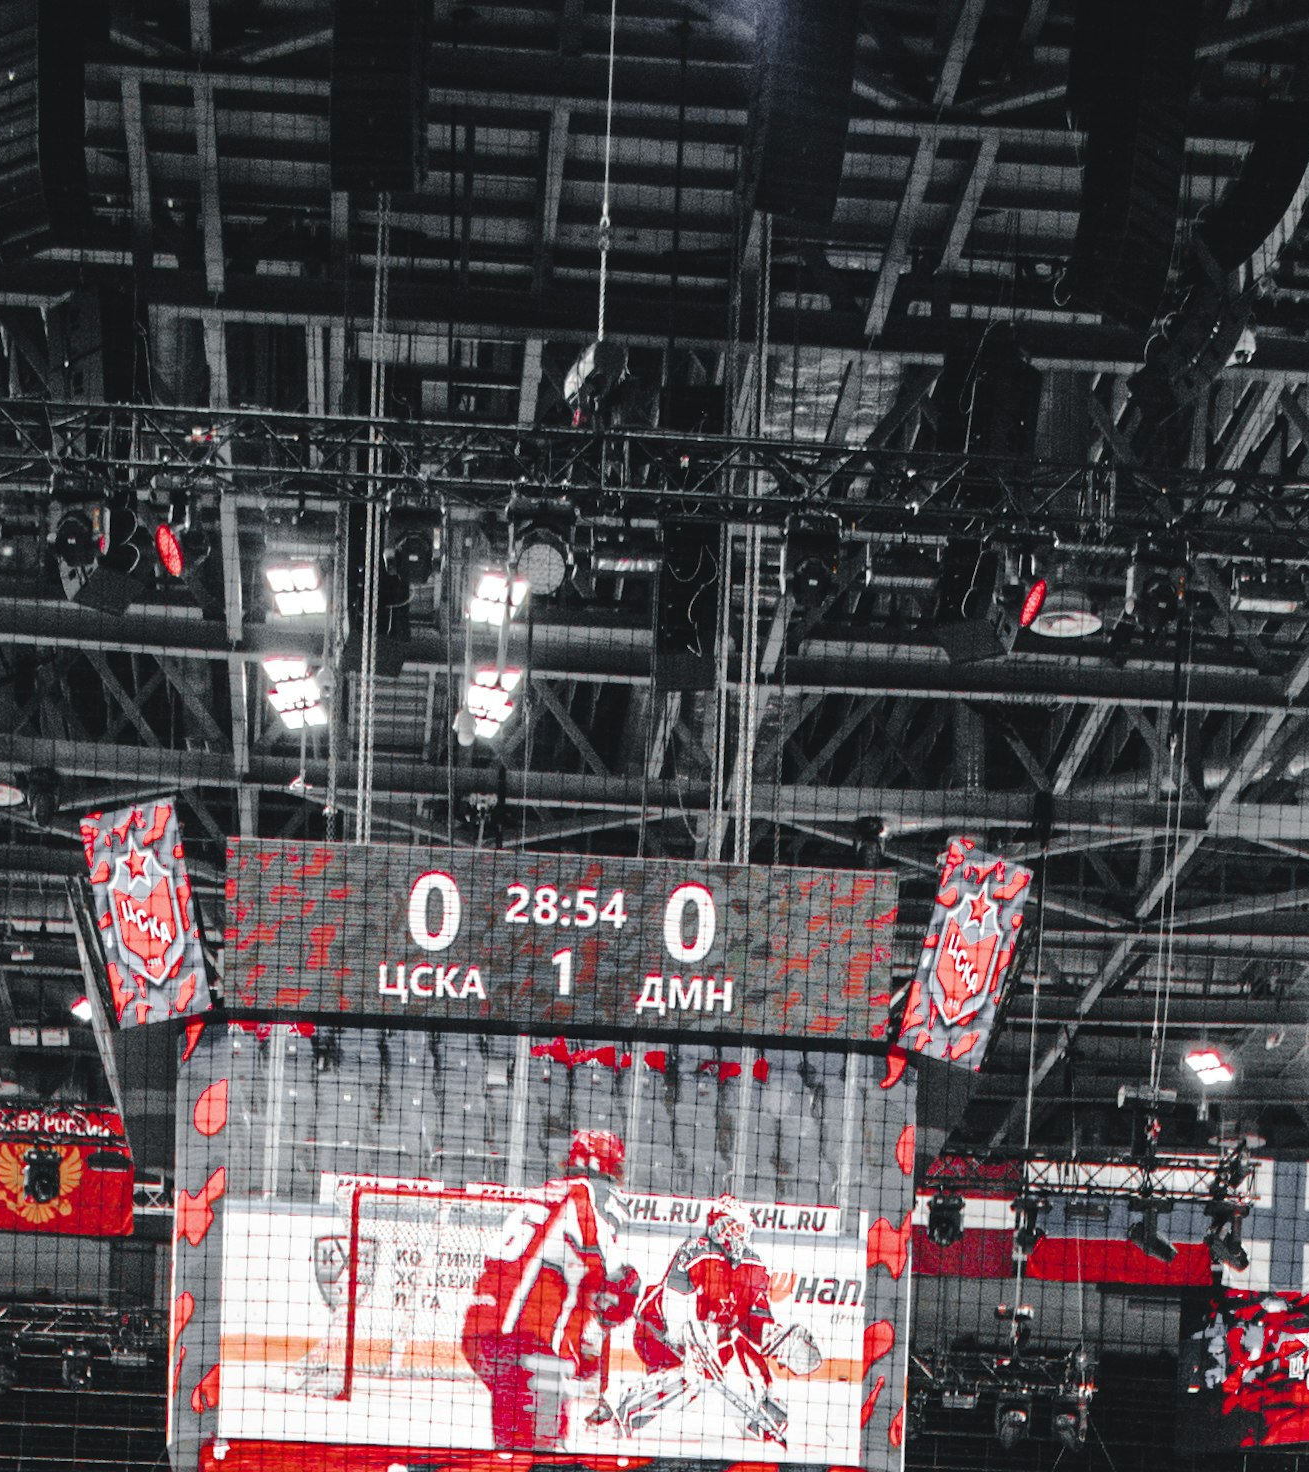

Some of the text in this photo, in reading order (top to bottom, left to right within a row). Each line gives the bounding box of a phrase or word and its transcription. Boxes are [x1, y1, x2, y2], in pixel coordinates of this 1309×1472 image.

[121, 899, 173, 945] ЦСКА
[408, 870, 461, 951] 0
[505, 882, 627, 929] 28:54
[663, 881, 717, 963] 0
[378, 960, 487, 1004] ЦСКА
[552, 947, 572, 996] 1
[946, 933, 979, 995] ЦСКА
[635, 972, 734, 1016] ДМН
